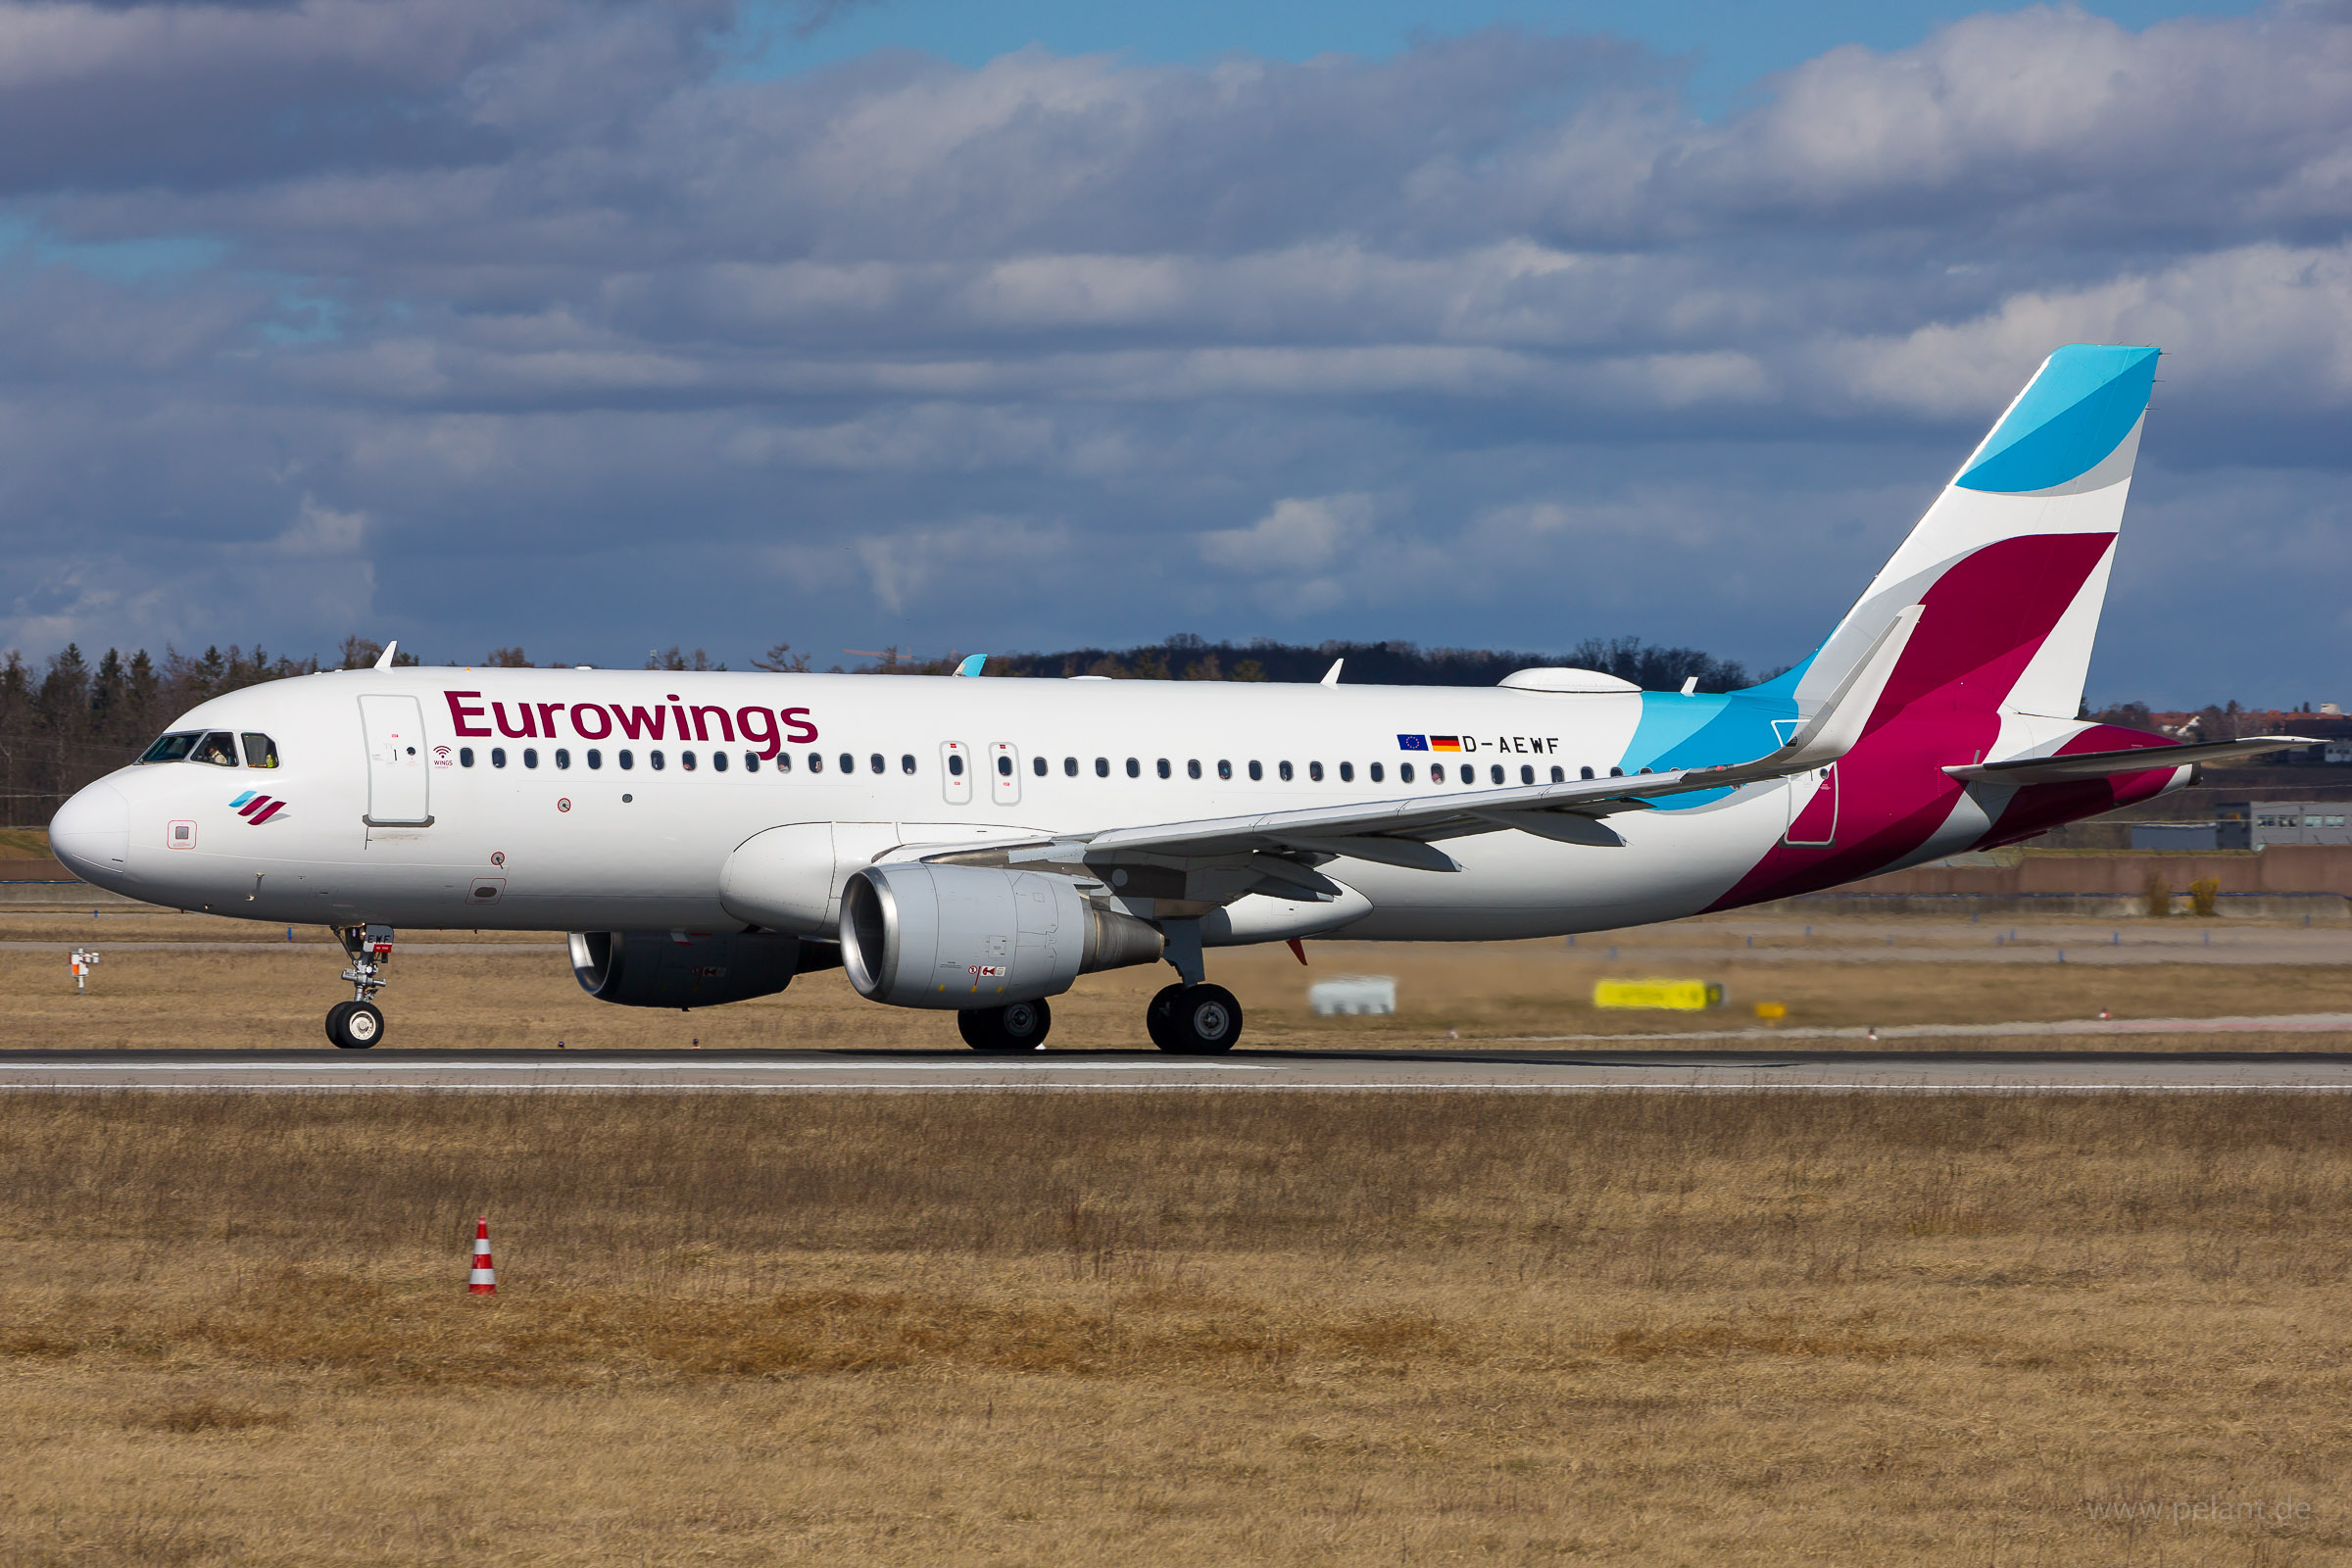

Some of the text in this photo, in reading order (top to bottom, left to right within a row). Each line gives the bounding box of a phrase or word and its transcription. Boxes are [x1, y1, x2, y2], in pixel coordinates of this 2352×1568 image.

[445, 691, 817, 761] Eurowings
[1462, 735, 1559, 755] D-AEWF
[368, 934, 391, 944] EWF
